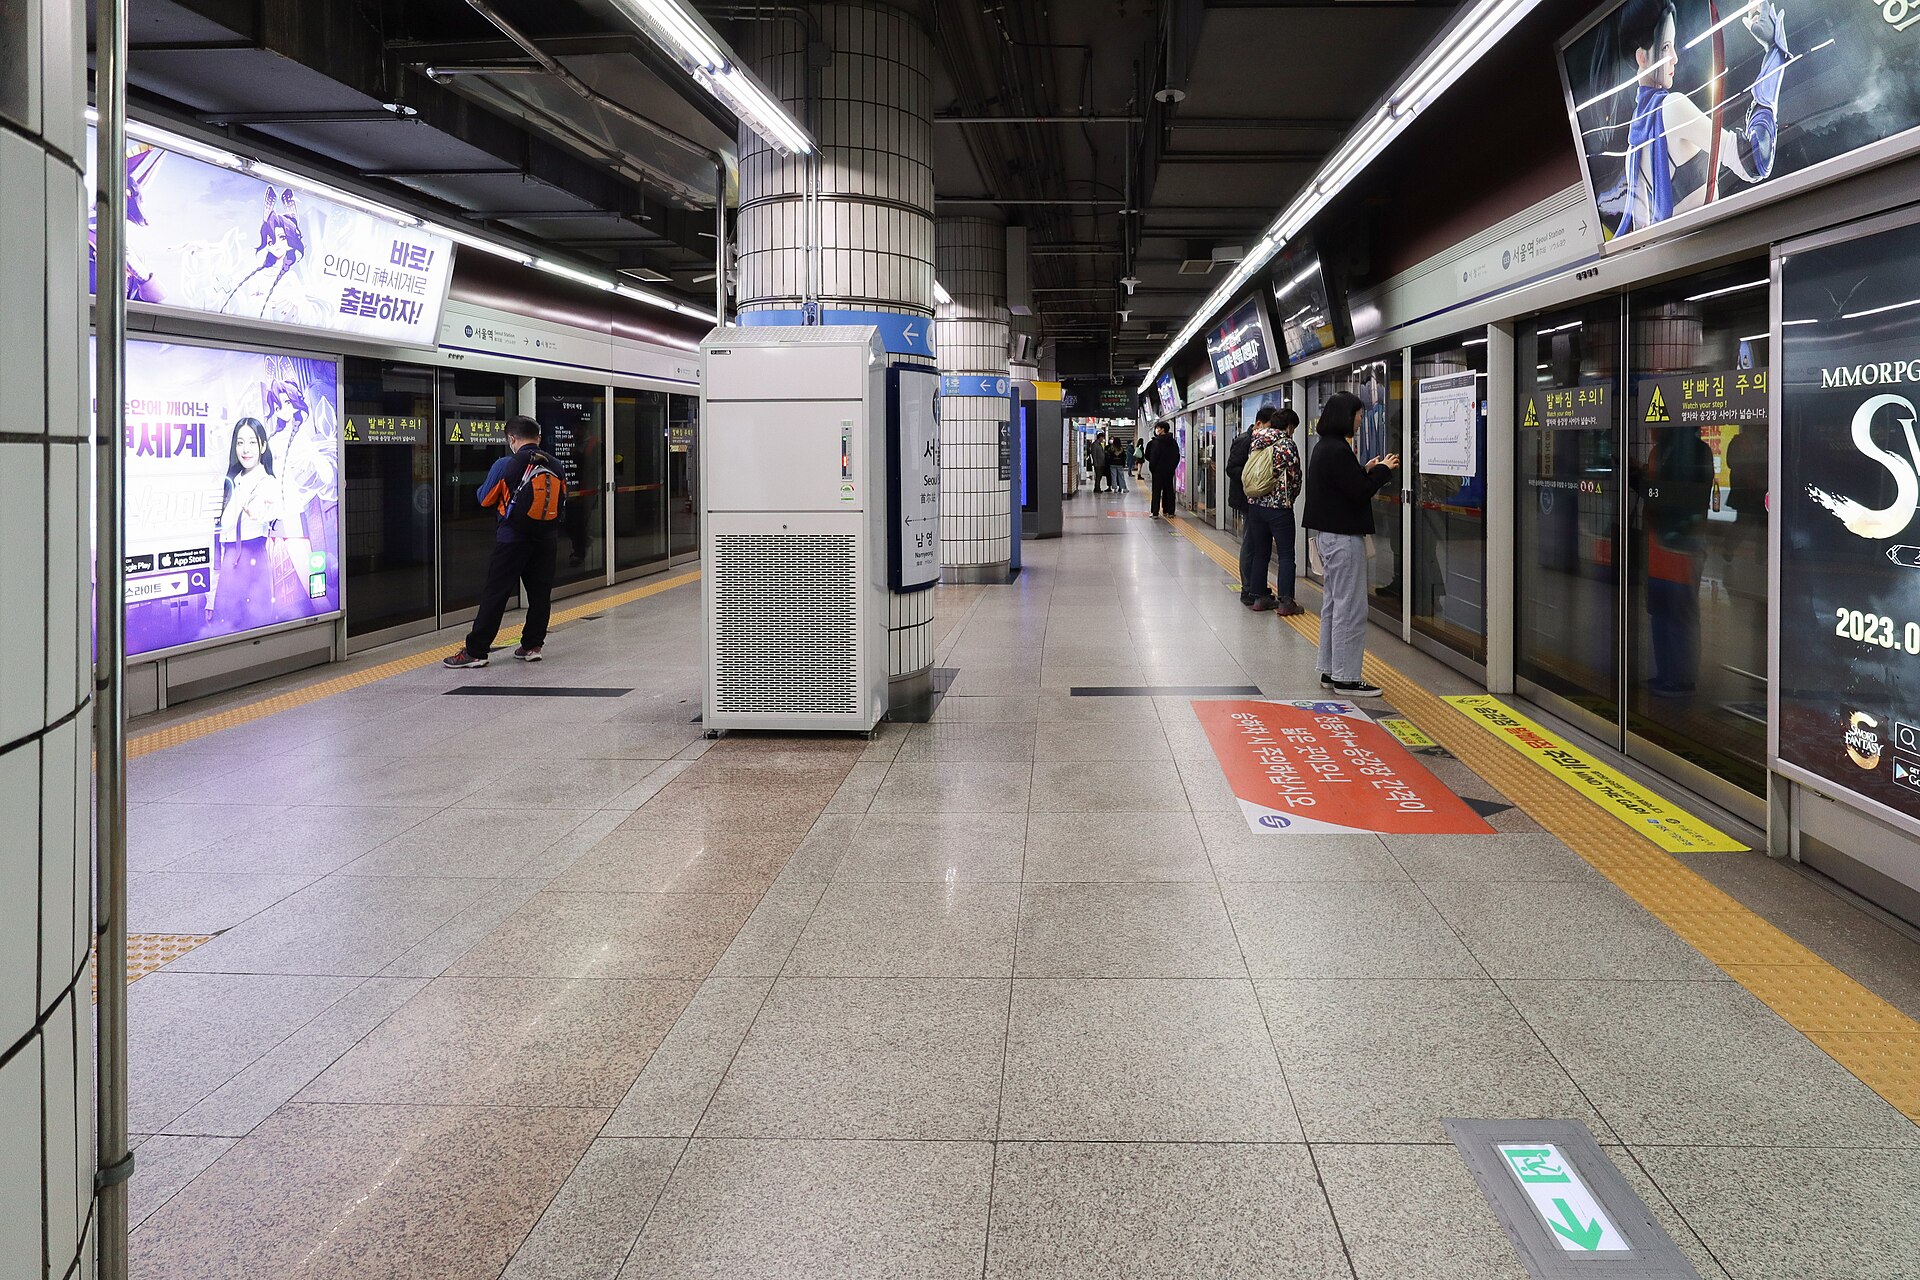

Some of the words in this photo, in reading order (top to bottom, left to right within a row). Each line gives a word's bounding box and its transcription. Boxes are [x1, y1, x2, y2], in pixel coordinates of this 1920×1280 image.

[390, 240, 434, 272] 바로!
[1512, 240, 1535, 264] 서울역
[324, 254, 370, 283] 인아의
[372, 268, 427, 295] 神세계로
[340, 287, 424, 324] 출발하자!
[474, 327, 494, 342] 서울역
[1682, 375, 1724, 400] 발빠짐
[1735, 371, 1767, 396] 주의
[1546, 391, 1573, 410] 발빠짐
[1578, 387, 1604, 408] 주의!
[1682, 401, 1699, 410] Watch
[1700, 402, 1711, 410] your
[167, 401, 210, 417] 깨어난
[368, 417, 396, 430] 발빠짐
[399, 419, 421, 430] 주의!
[470, 421, 491, 433] 발빠짐
[1648, 487, 1659, 498] 8-3
[915, 531, 933, 549] 남영
[138, 562, 152, 571] Play
[173, 557, 188, 567] App
[189, 554, 207, 564] Store
[1231, 712, 1270, 735] 승하차
[1247, 735, 1277, 745] 시
[1280, 727, 1317, 744] 넓은
[1848, 724, 1878, 743] SWORD
[1844, 731, 1885, 757] FANTASY
[1293, 746, 1352, 783] 곳이오니
[1543, 750, 1591, 769] 주의!
[1251, 747, 1317, 808] 주의하십시오
[1371, 779, 1434, 813] 간격이
[1572, 771, 1603, 786] MIND
[1596, 786, 1624, 799] THE
[1616, 799, 1651, 815] GAP!
